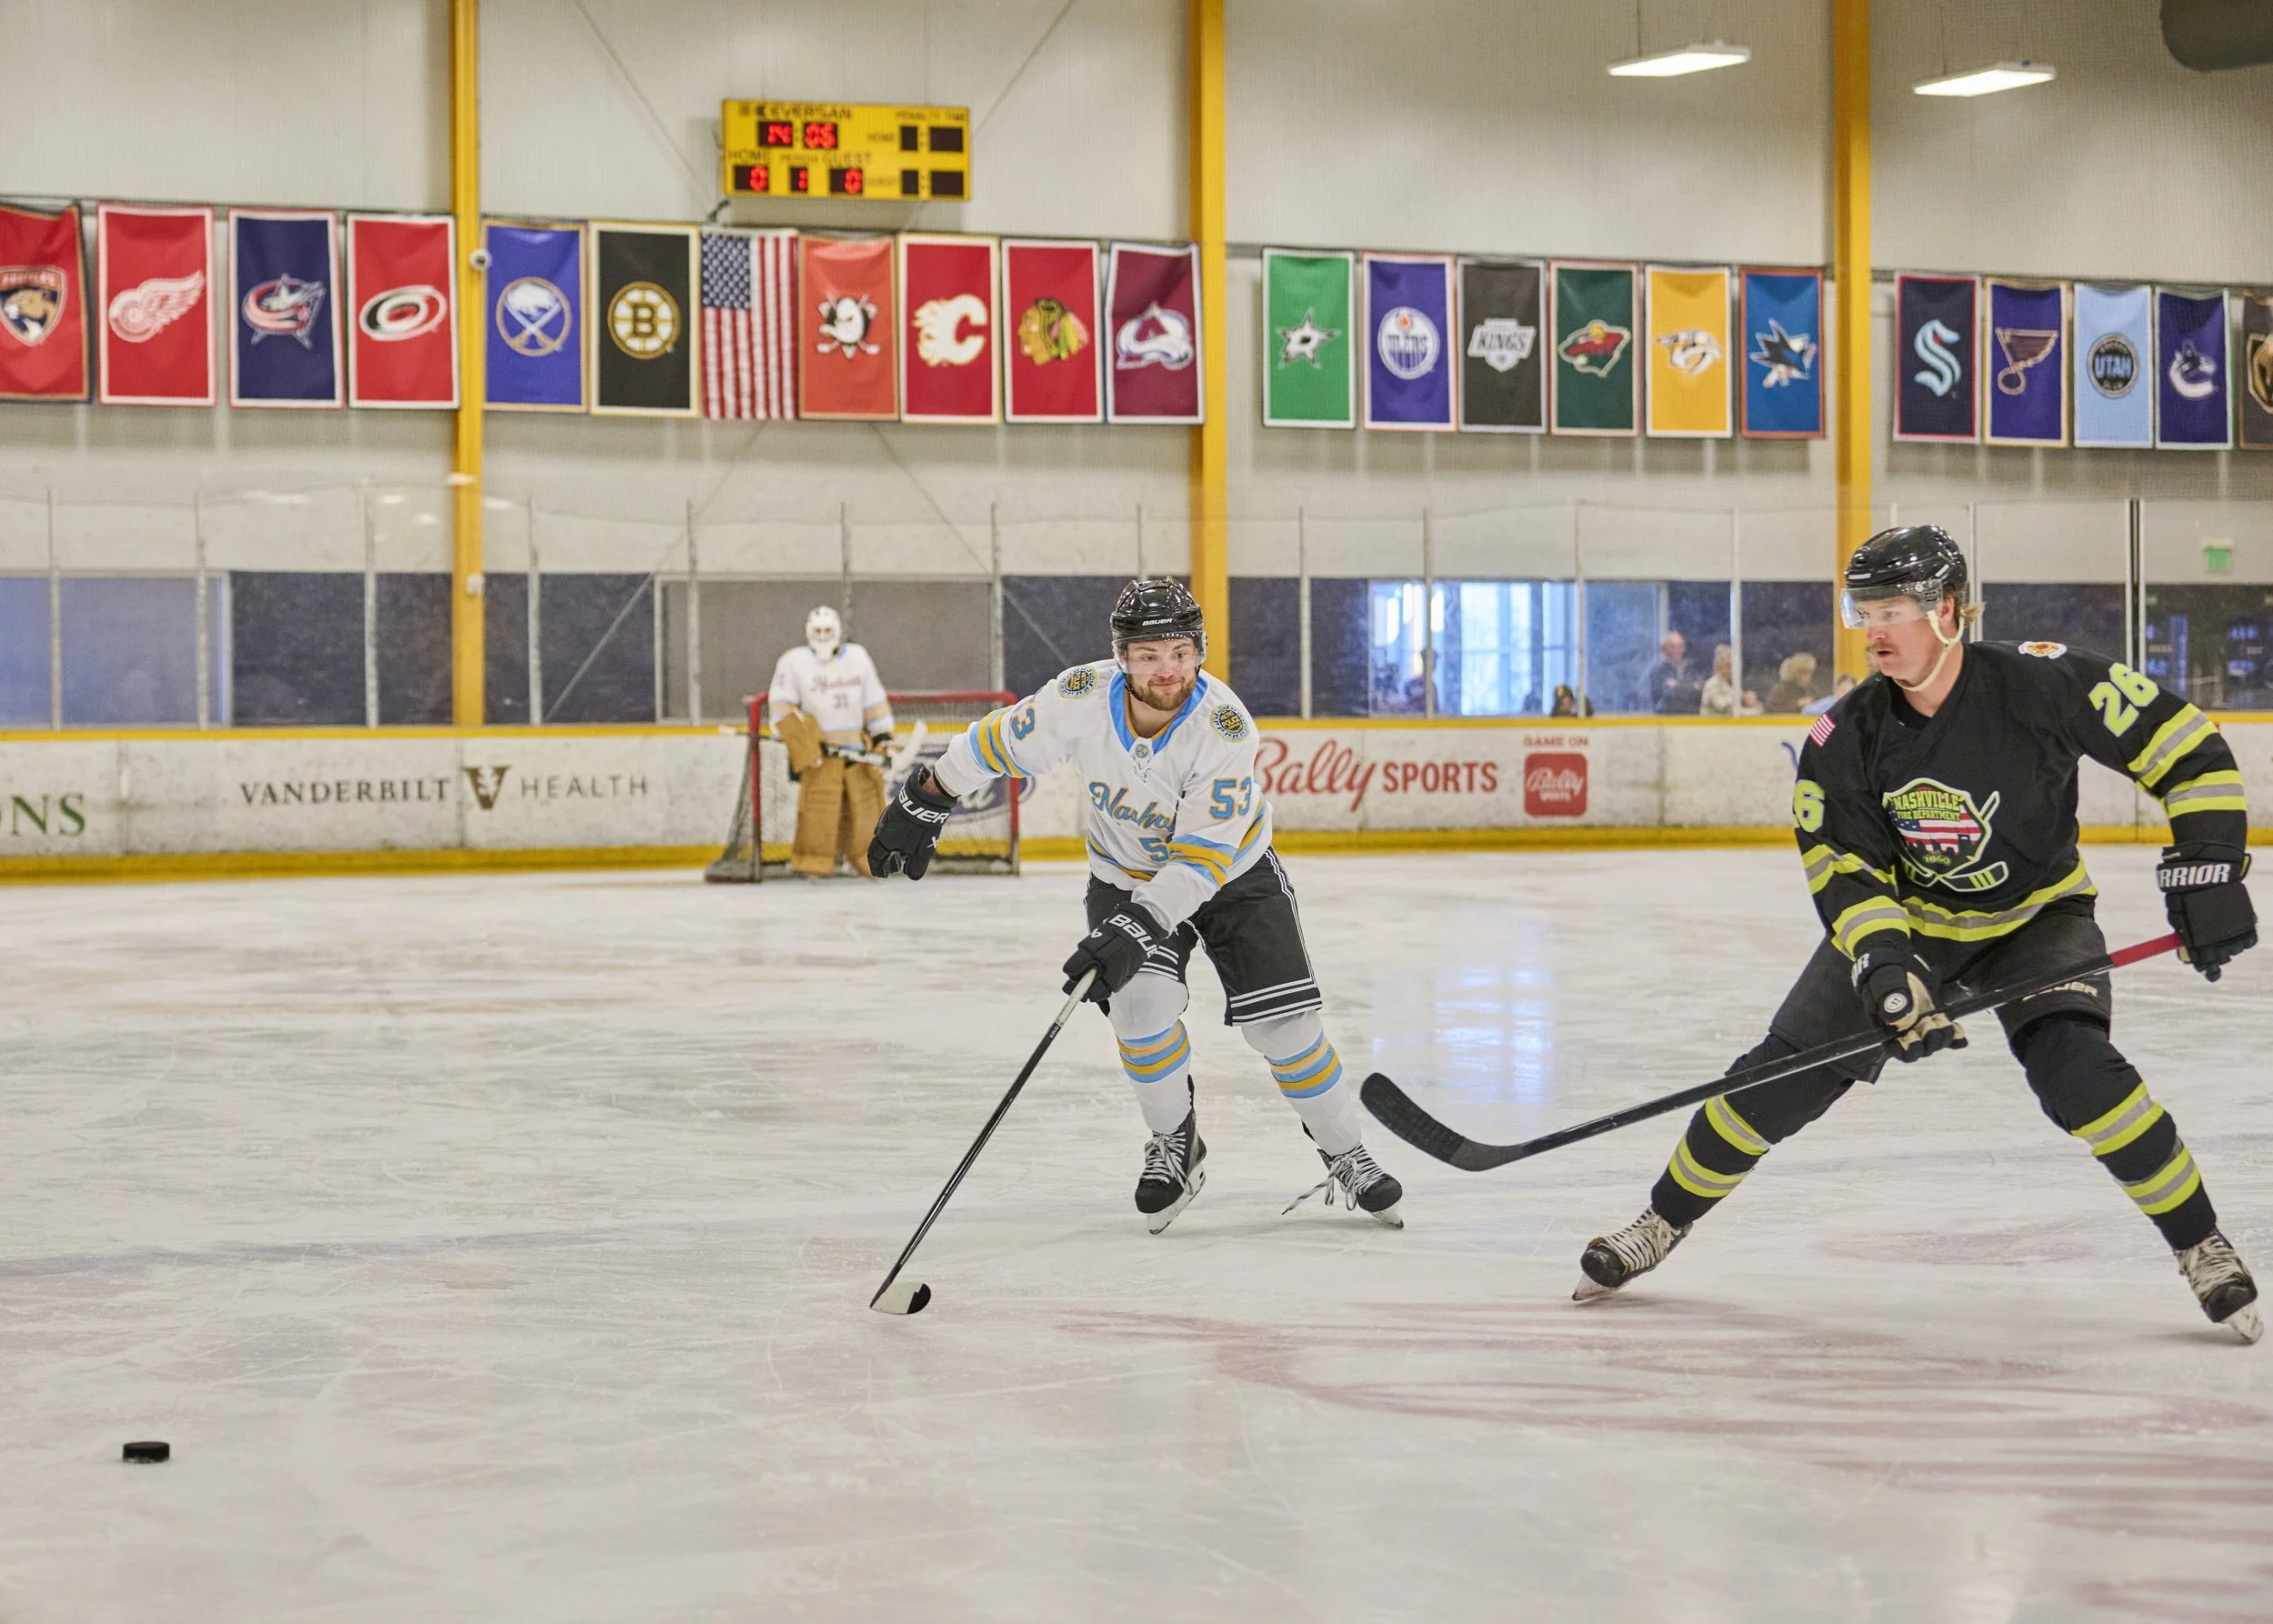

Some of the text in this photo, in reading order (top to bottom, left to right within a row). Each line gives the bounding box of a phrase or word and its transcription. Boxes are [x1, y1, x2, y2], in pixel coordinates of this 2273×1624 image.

[1477, 330, 1529, 352] KINGS
[2095, 356, 2133, 378] UTAH
[2088, 663, 2160, 737] 26
[1524, 735, 1588, 747] GAME ON
[1256, 737, 1499, 813] Bally SPORTS
[239, 765, 648, 810] VANDERBILT V HEALTH
[1209, 777, 1252, 820] 53
[1893, 790, 1961, 811] NASHVILLE
[1897, 809, 1960, 822] FIRE DEPARTMENT
[1924, 854, 1950, 866] 1860
